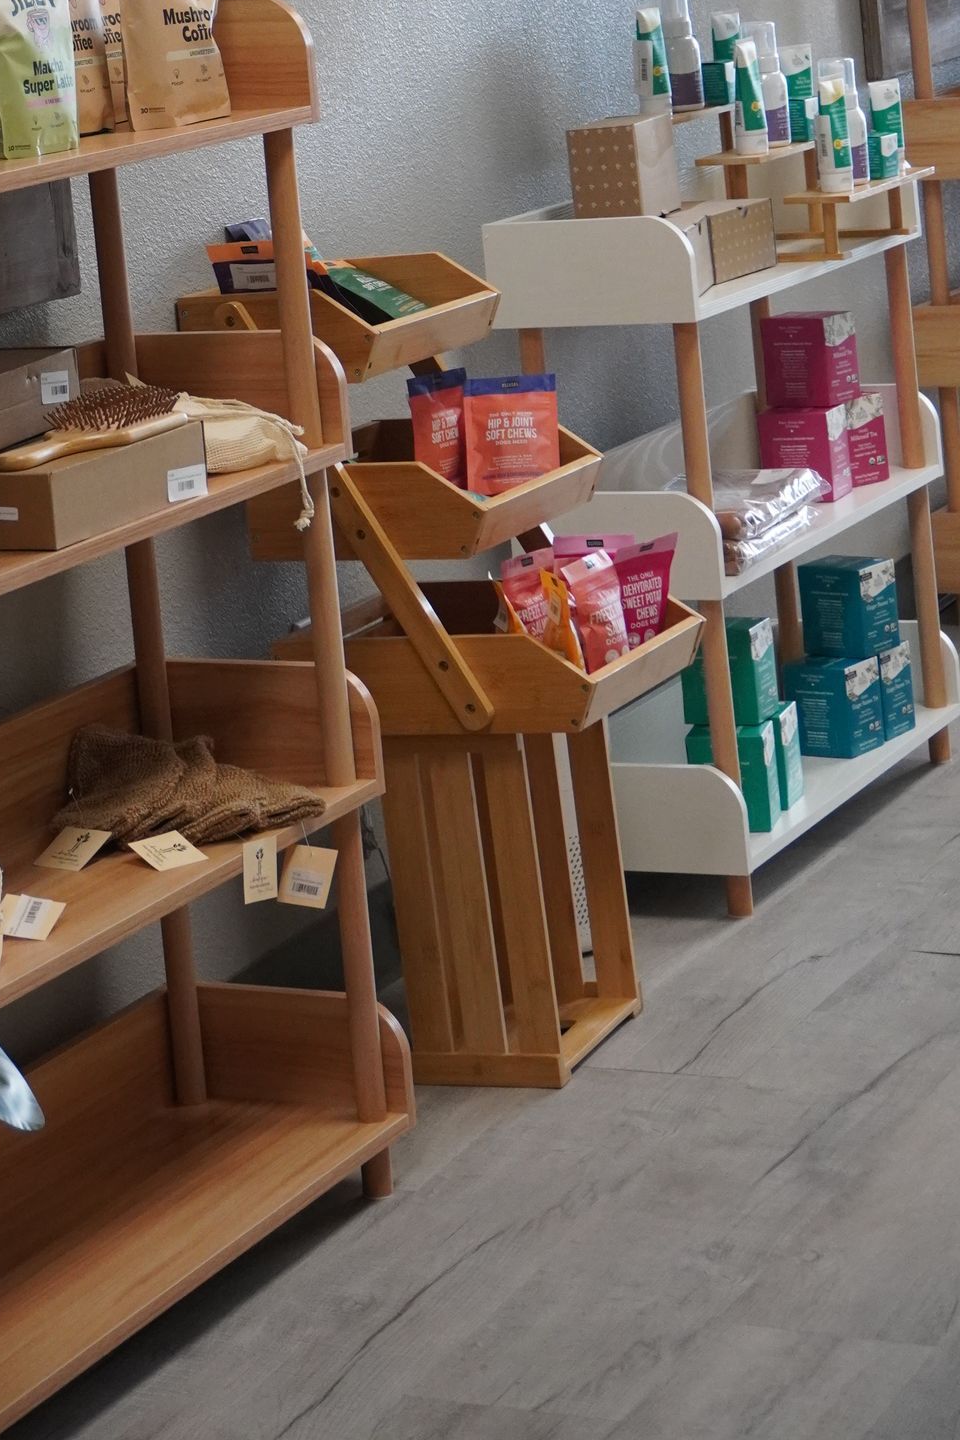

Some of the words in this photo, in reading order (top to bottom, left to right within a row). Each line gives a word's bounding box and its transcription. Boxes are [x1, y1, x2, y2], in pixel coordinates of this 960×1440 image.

[163, 6, 212, 25] Mushro
[182, 24, 212, 42] Coff
[73, 33, 93, 51] ffee
[33, 60, 64, 76] Matcha
[23, 79, 54, 96] Super
[487, 418, 501, 429] HIP
[503, 417, 510, 428] &
[511, 416, 534, 428] JOINT
[445, 427, 459, 441] CHEW
[486, 429, 506, 441] SOFT
[507, 428, 537, 439] CHEWS
[623, 576, 662, 597] DEHYDRATED
[621, 593, 645, 609] SWEET
[636, 604, 657, 620] CHEWS
